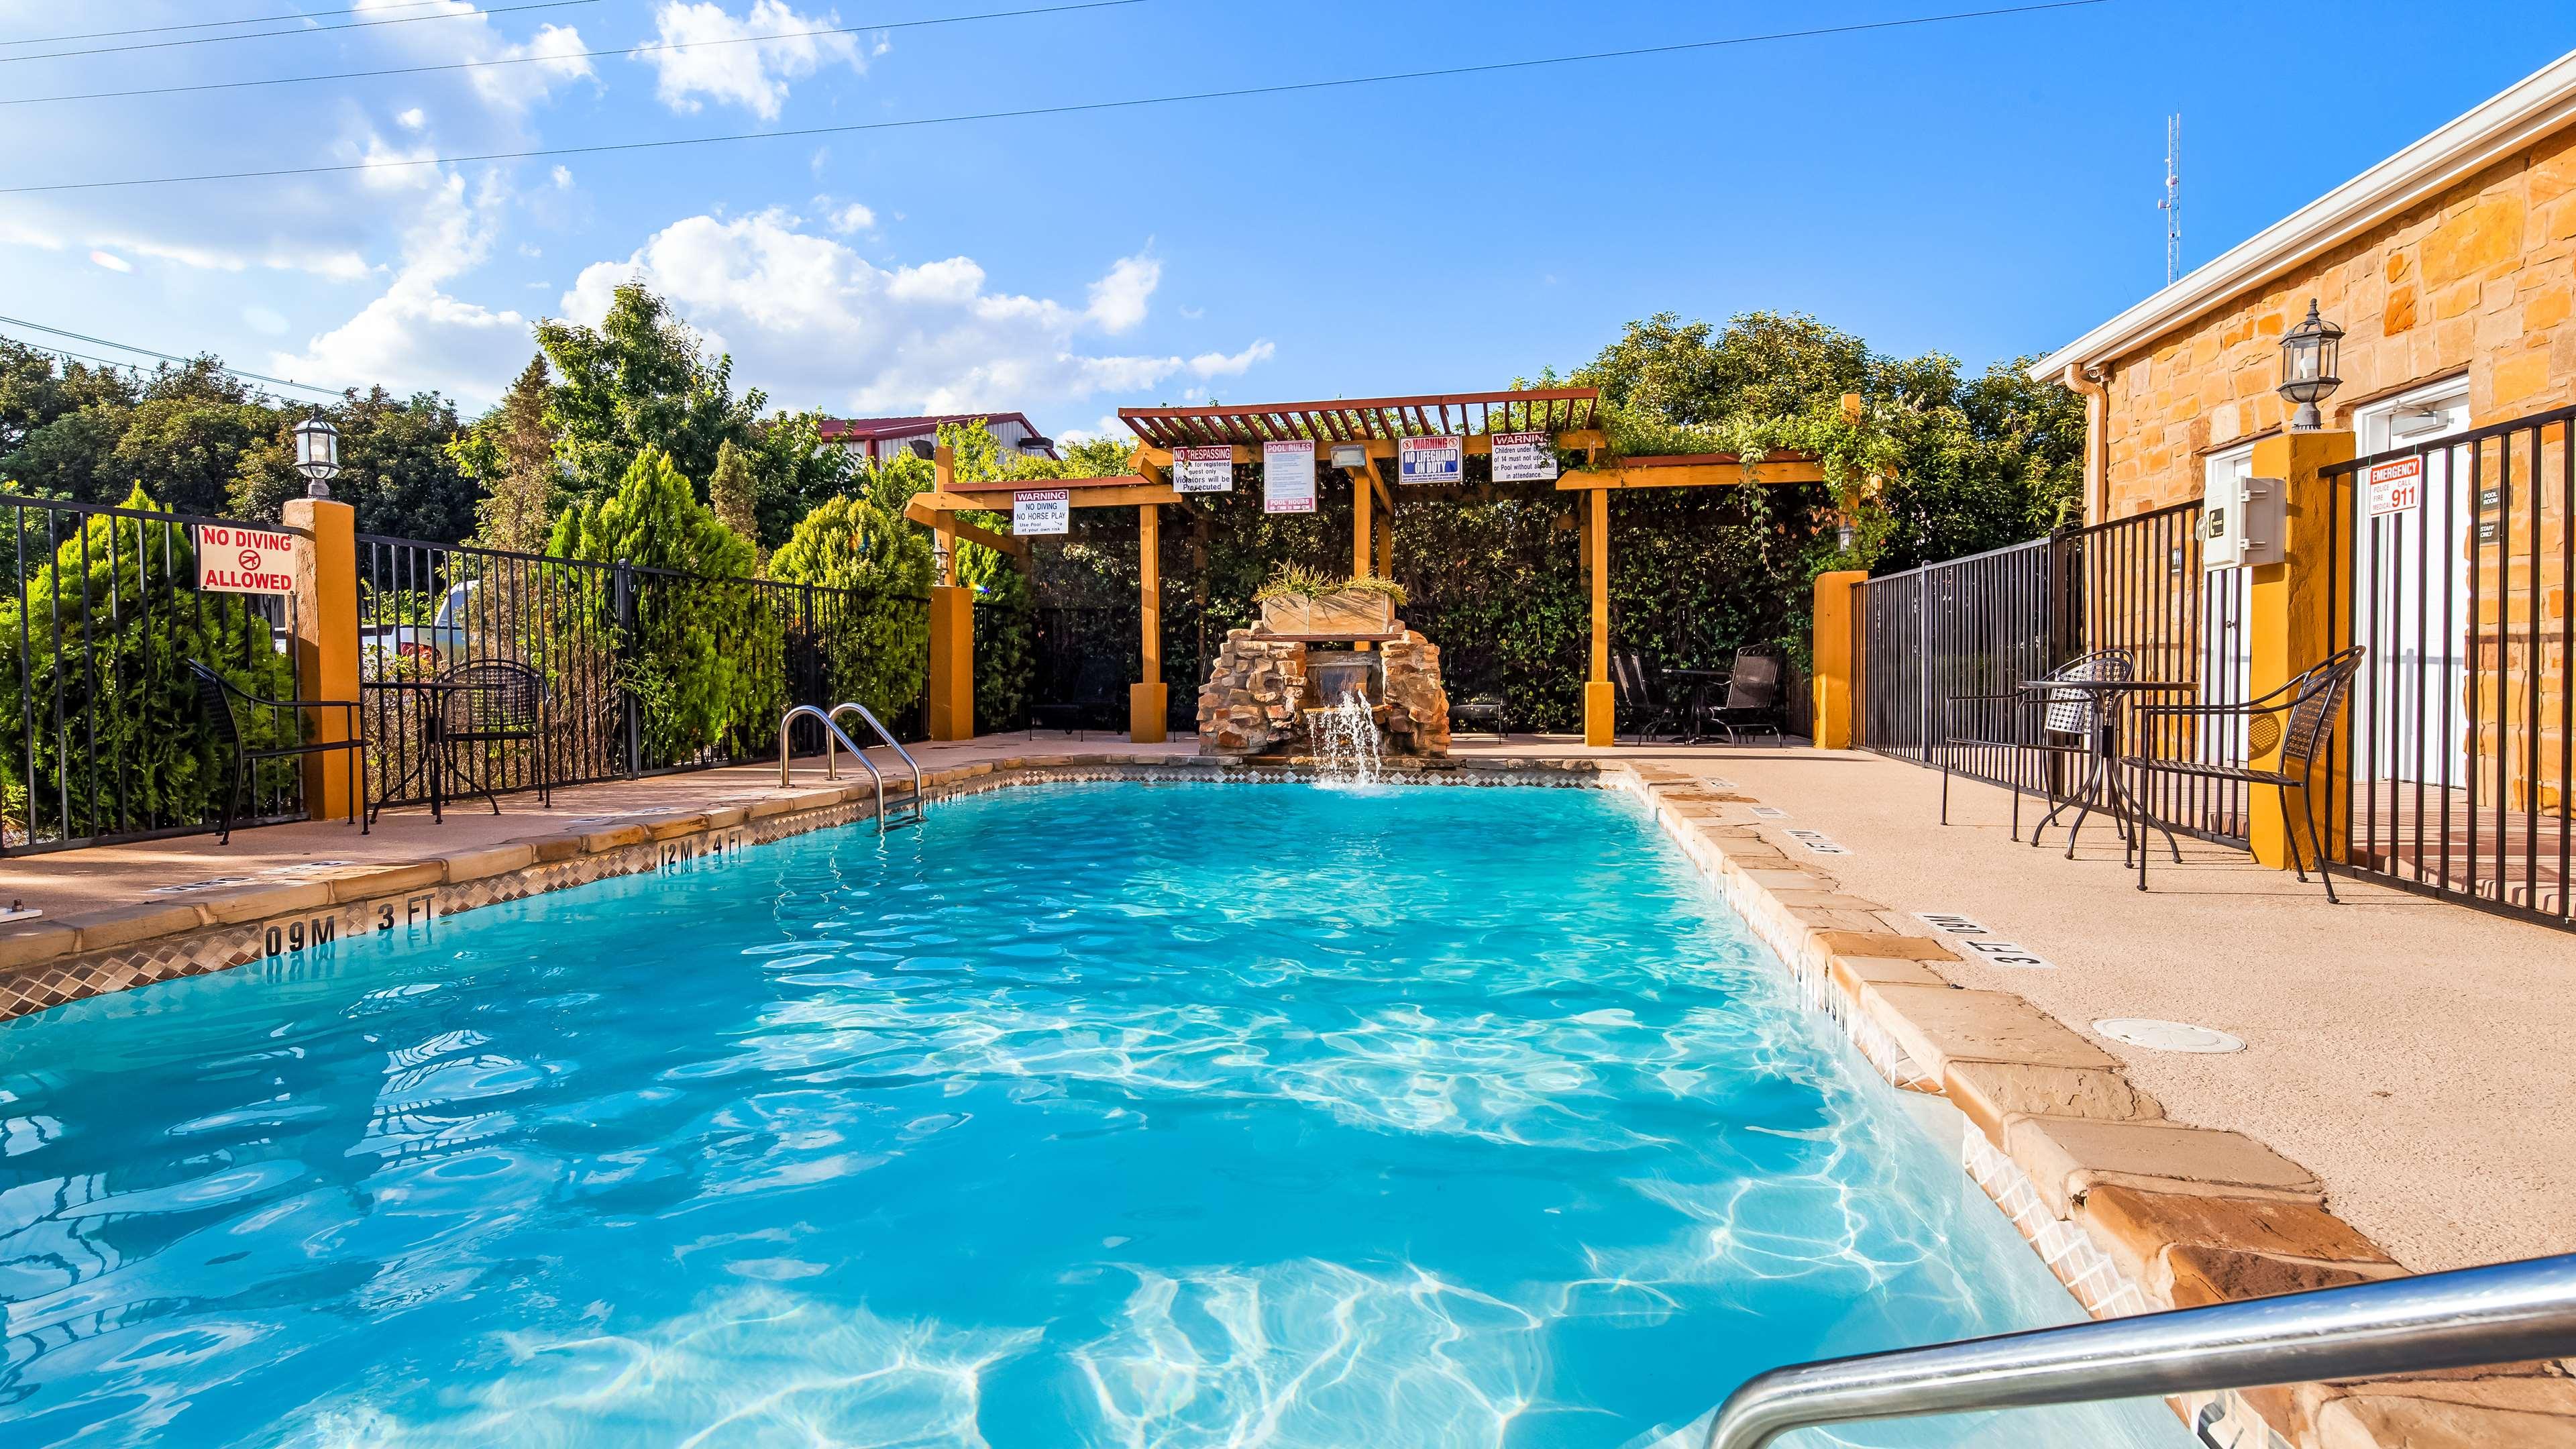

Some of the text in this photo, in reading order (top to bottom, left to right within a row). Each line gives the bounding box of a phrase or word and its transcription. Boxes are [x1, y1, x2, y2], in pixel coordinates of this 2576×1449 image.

[1268, 443, 1311, 452] POOL RULES
[1413, 438, 1447, 450] WARNING
[1175, 449, 1230, 460] NO TRESPASSING
[1405, 450, 1456, 463] NO LIFEGUARD
[1415, 461, 1446, 474] ON DUTY
[2373, 461, 2417, 482] EMERGENCY
[2373, 484, 2389, 493] POLICE
[2398, 479, 2412, 488] CALL
[1017, 492, 1065, 500] WARNING
[2392, 486, 2414, 508] 911
[2373, 502, 2392, 511] MEDICAL
[204, 528, 291, 551] NO DIVING
[205, 570, 292, 590] ALLOWED
[713, 834, 722, 855] 4
[729, 829, 743, 854] FT
[378, 903, 394, 930] 3
[407, 893, 436, 926] FT
[1965, 941, 2024, 954] FT
